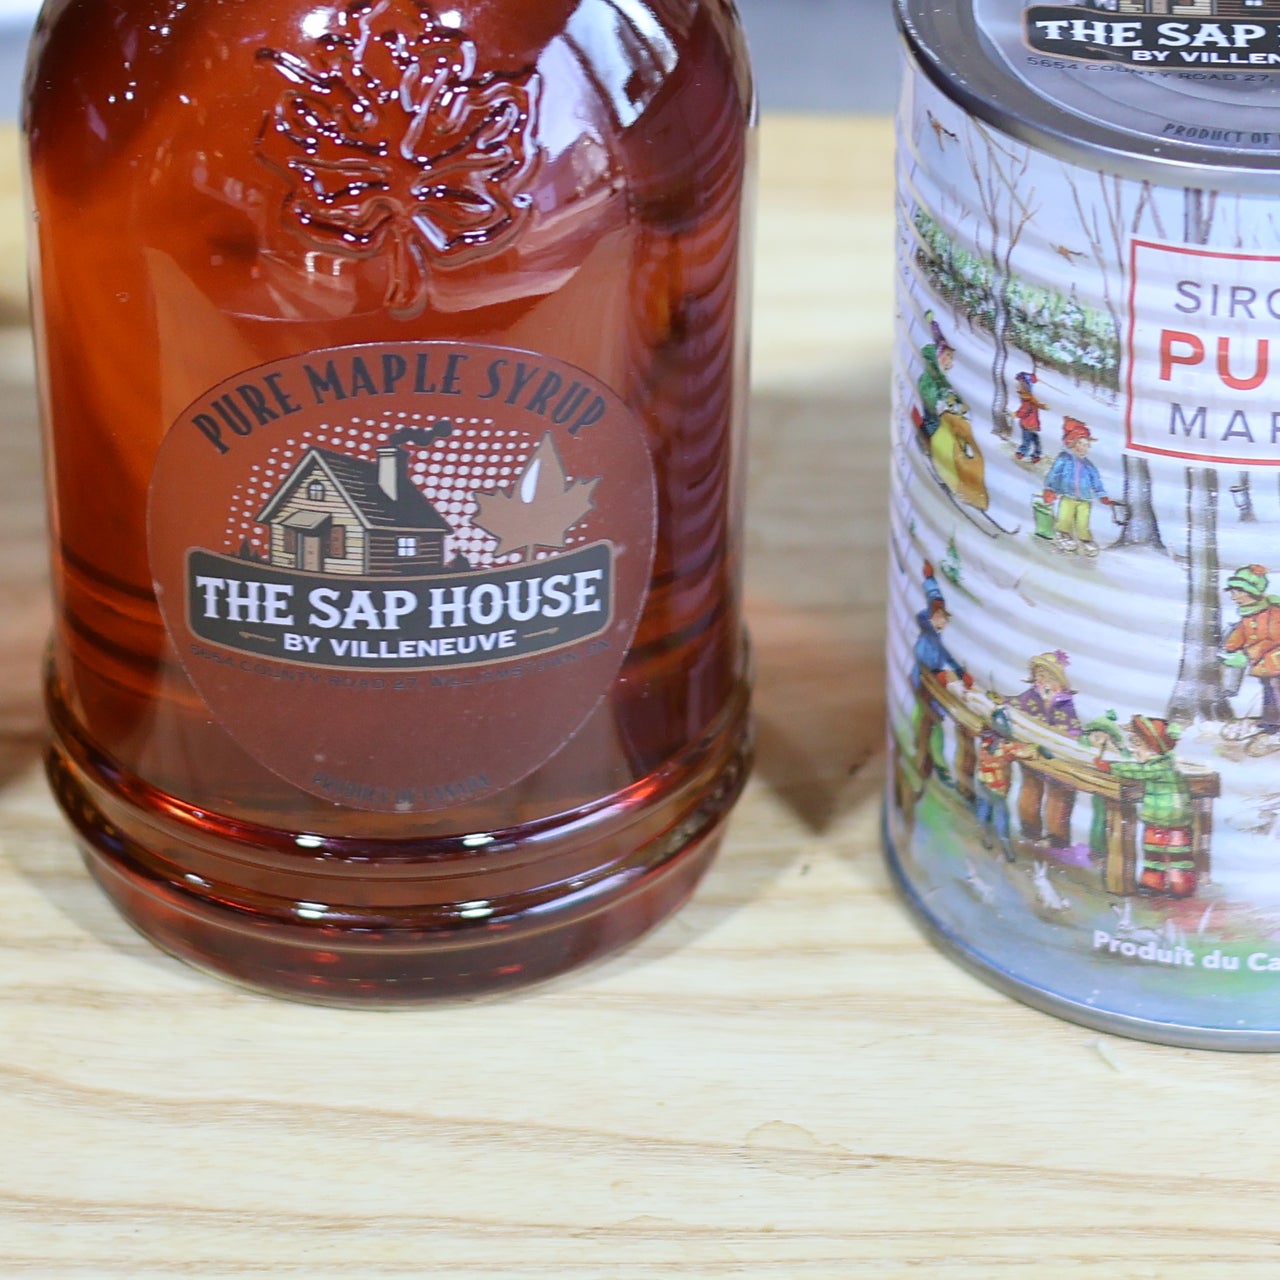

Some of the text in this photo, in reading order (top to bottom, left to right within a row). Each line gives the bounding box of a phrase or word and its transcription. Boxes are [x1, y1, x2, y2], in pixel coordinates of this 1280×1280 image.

[1035, 20, 1143, 48] THE
[1158, 22, 1266, 50] SAP
[1026, 56, 1079, 71] 5654
[1085, 63, 1171, 80] COUNTY
[1179, 72, 1237, 82] ROAD
[1131, 50, 1171, 63] BY
[1163, 122, 1245, 145] PRODUCT
[1250, 131, 1270, 145] OF
[191, 352, 606, 454] PURE MAPLE SYRUP
[195, 569, 603, 630] THE SAP HOUSE
[283, 629, 517, 659] BY VILLENEUVE
[1092, 931, 1193, 969] Produit
[1202, 946, 1240, 972] du
